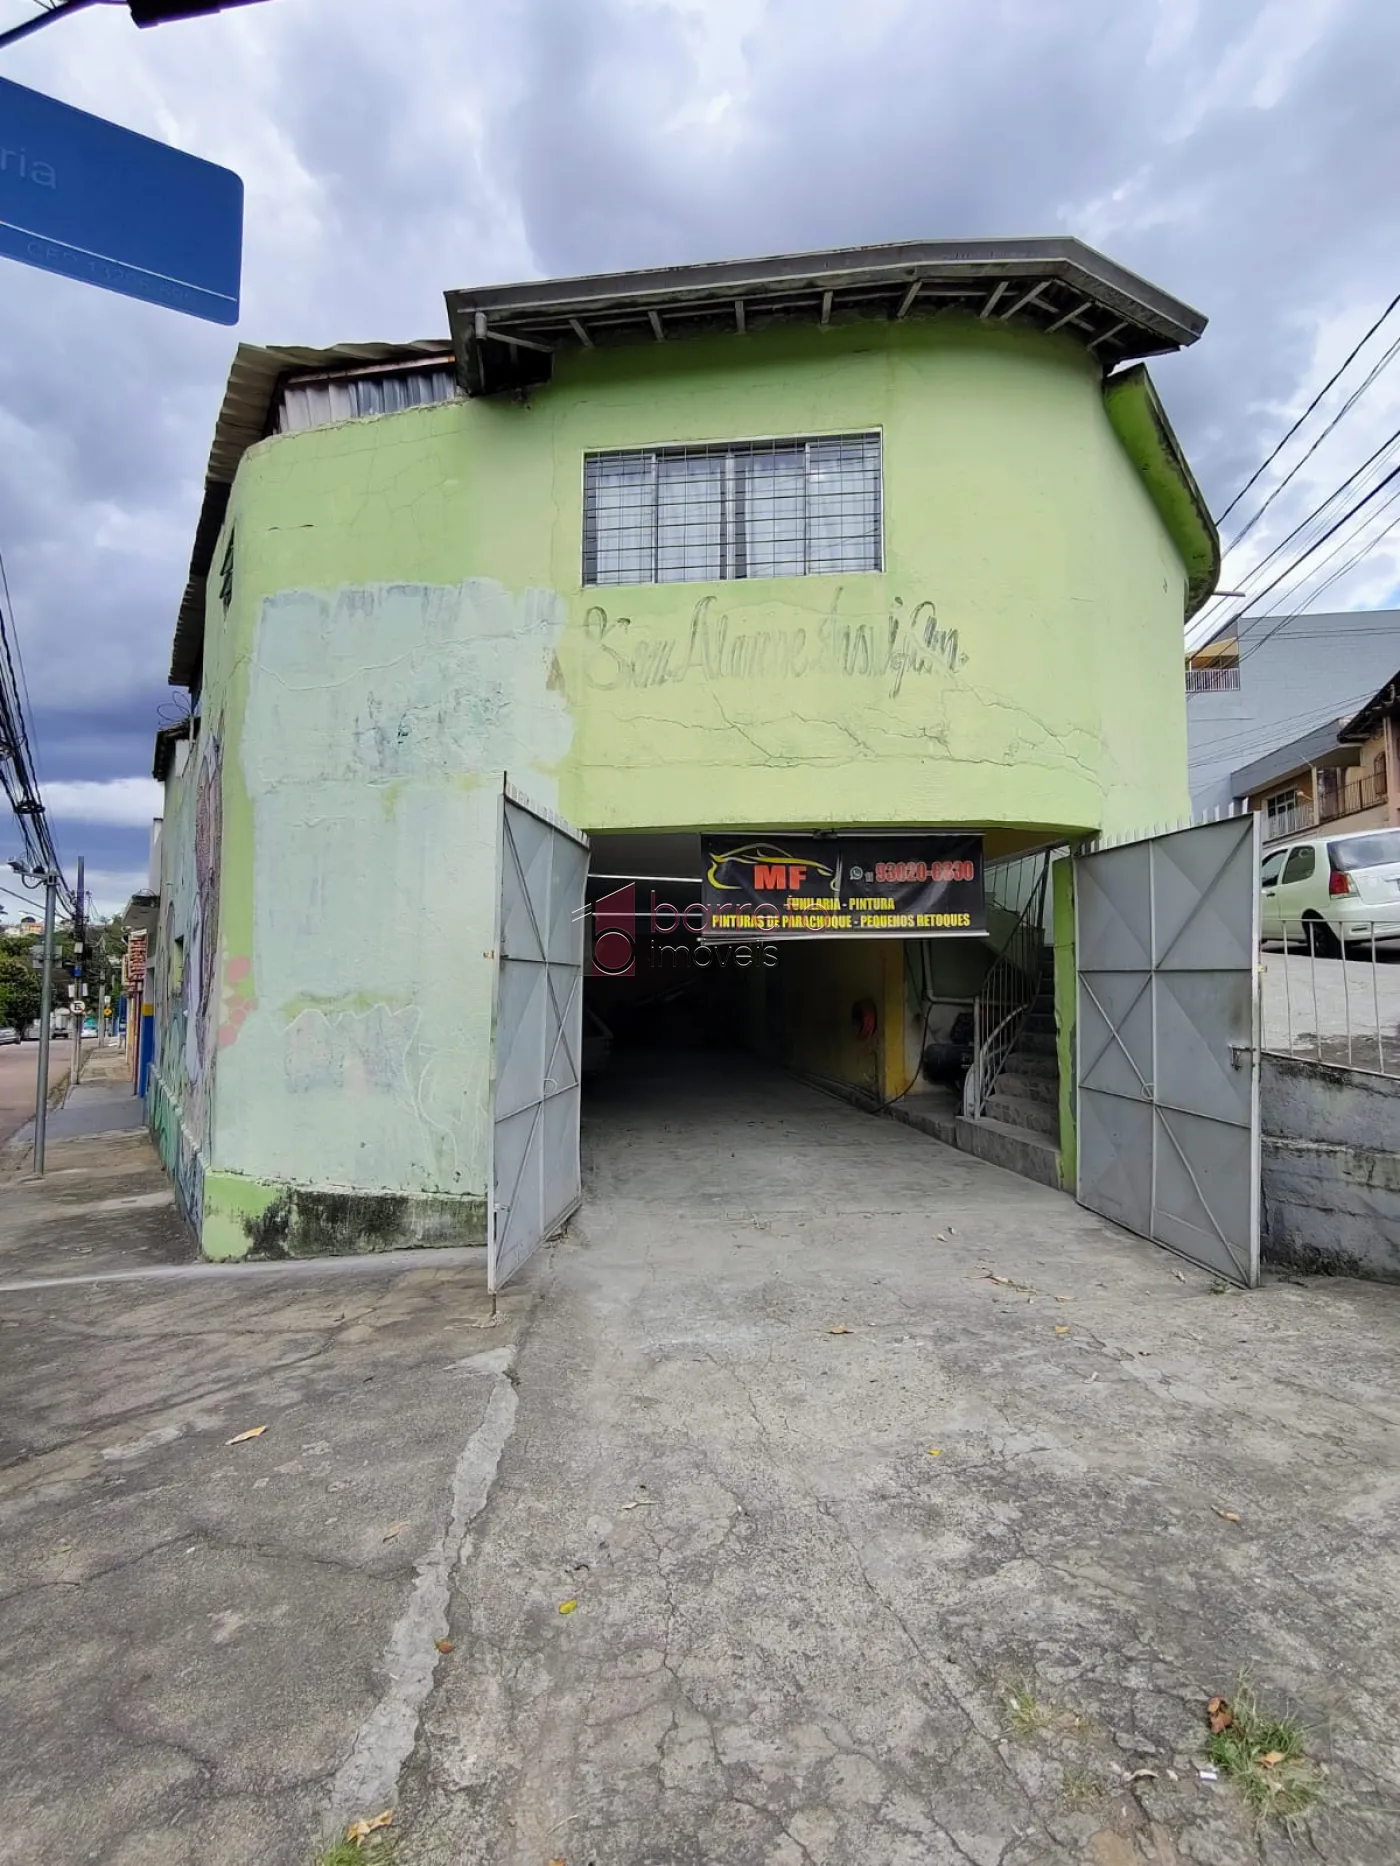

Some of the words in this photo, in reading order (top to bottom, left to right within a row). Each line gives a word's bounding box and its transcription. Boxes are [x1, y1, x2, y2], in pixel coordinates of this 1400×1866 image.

[754, 864, 807, 890] MF
[848, 897, 895, 911] PINTURA
[712, 914, 765, 928] PINTURAS
[767, 915, 780, 928] DE
[782, 914, 852, 929] PARACHOQUE
[860, 914, 915, 928] PEQUENOS
[916, 913, 971, 927] RETOQUES
